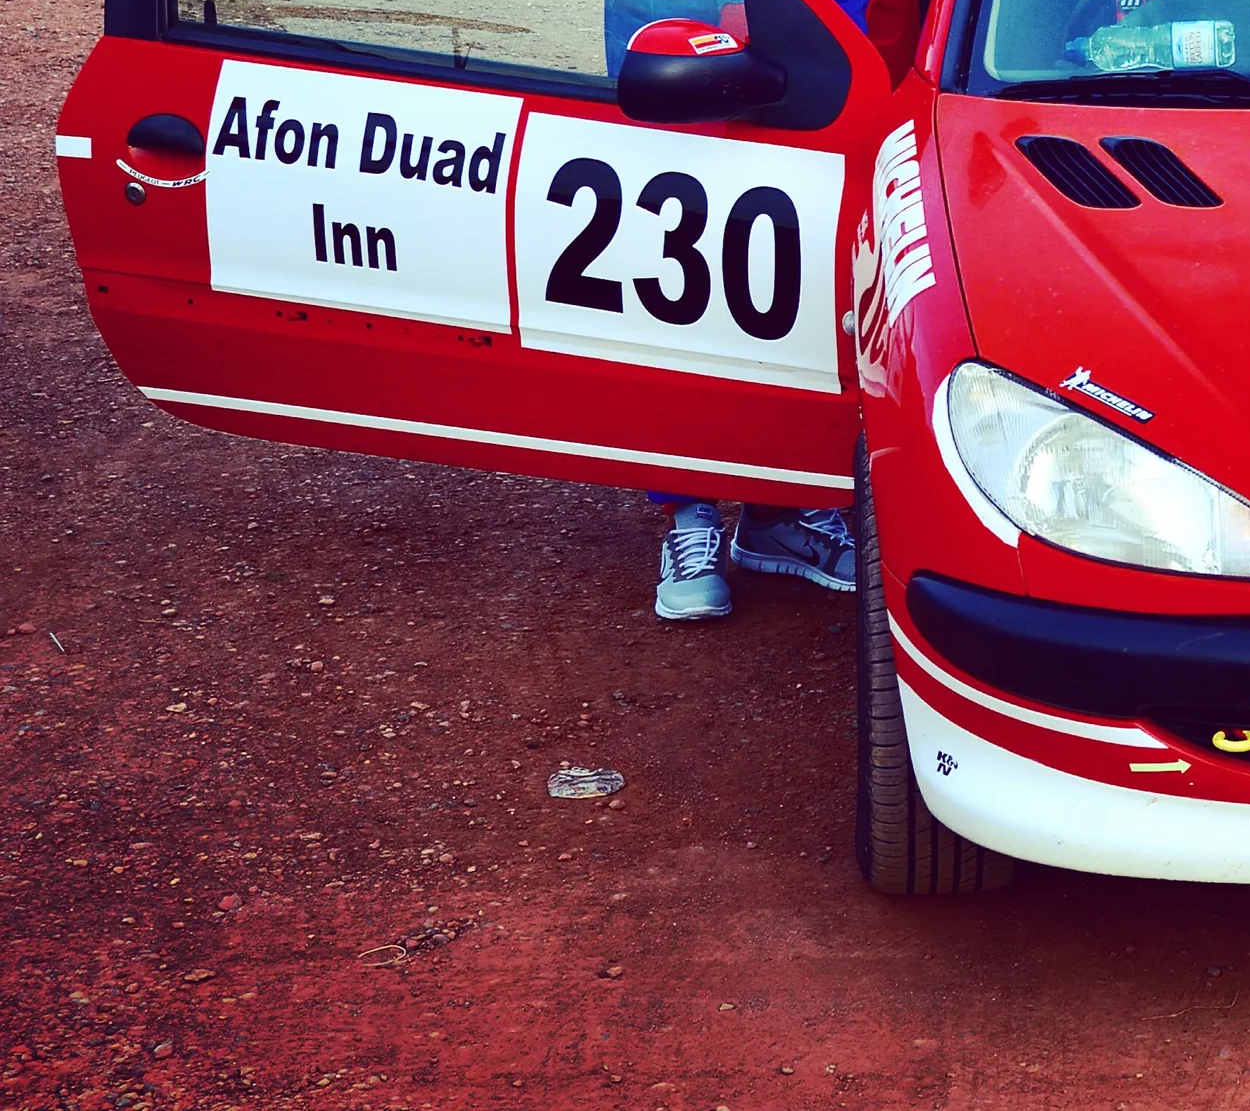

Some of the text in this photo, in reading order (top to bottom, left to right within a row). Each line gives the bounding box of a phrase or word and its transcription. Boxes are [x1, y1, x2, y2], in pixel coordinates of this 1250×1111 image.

[212, 96, 507, 194] Afon Duad
[172, 175, 201, 187] WRC
[312, 203, 398, 271] Inn
[544, 156, 802, 341] 230
[1082, 383, 1154, 420] MICHELIN
